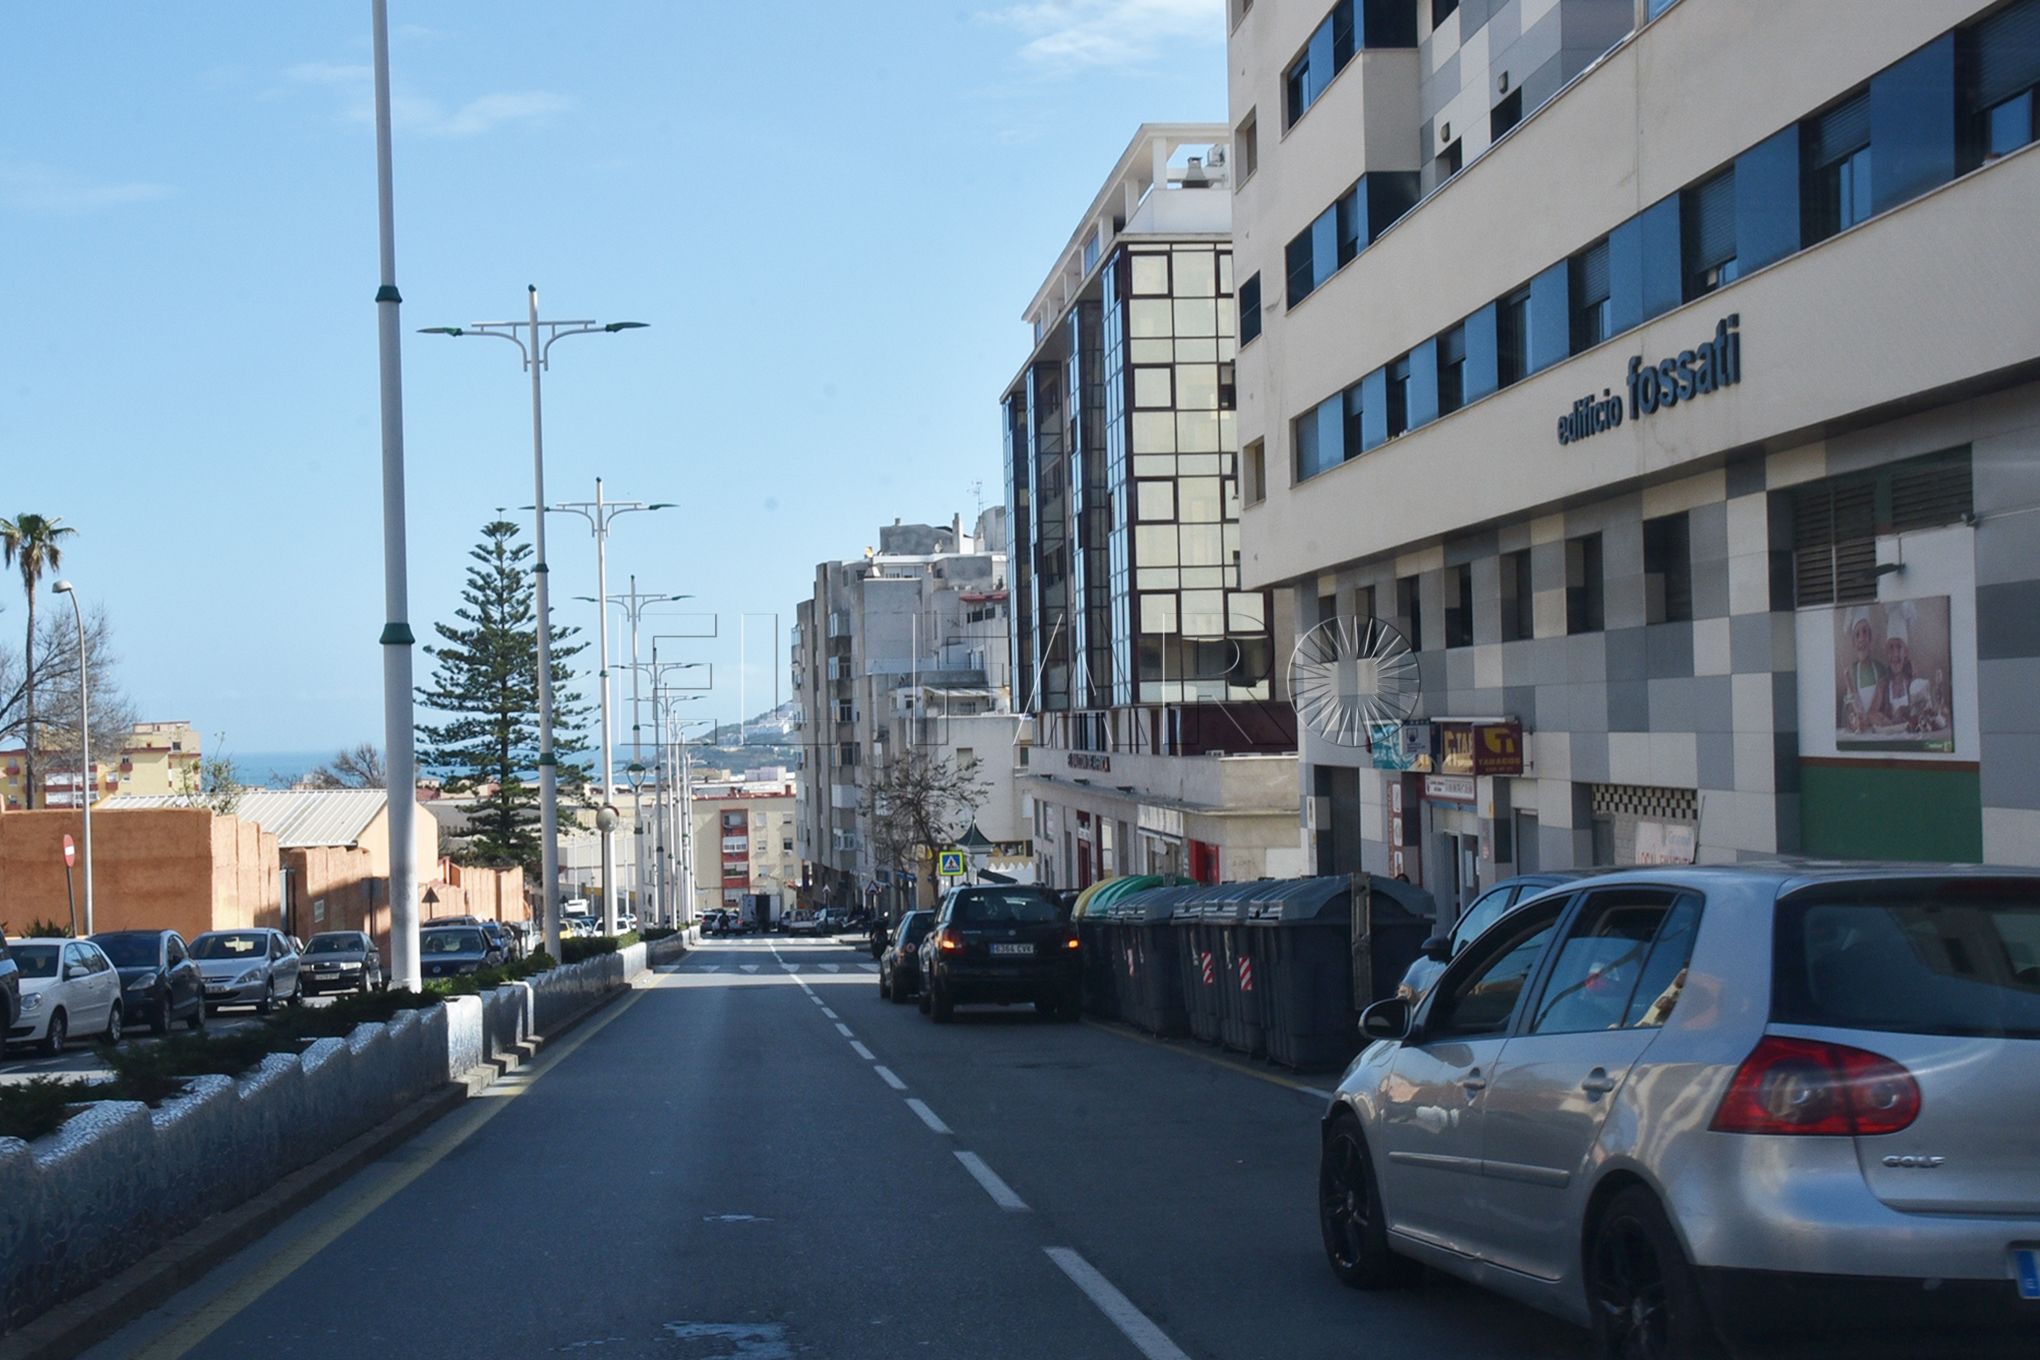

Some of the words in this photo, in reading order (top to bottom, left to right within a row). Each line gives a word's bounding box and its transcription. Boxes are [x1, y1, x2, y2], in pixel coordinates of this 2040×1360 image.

[1557, 388, 1623, 446] edificio
[1626, 313, 1741, 420] fossati
[1882, 1155, 1945, 1168] GOLF
